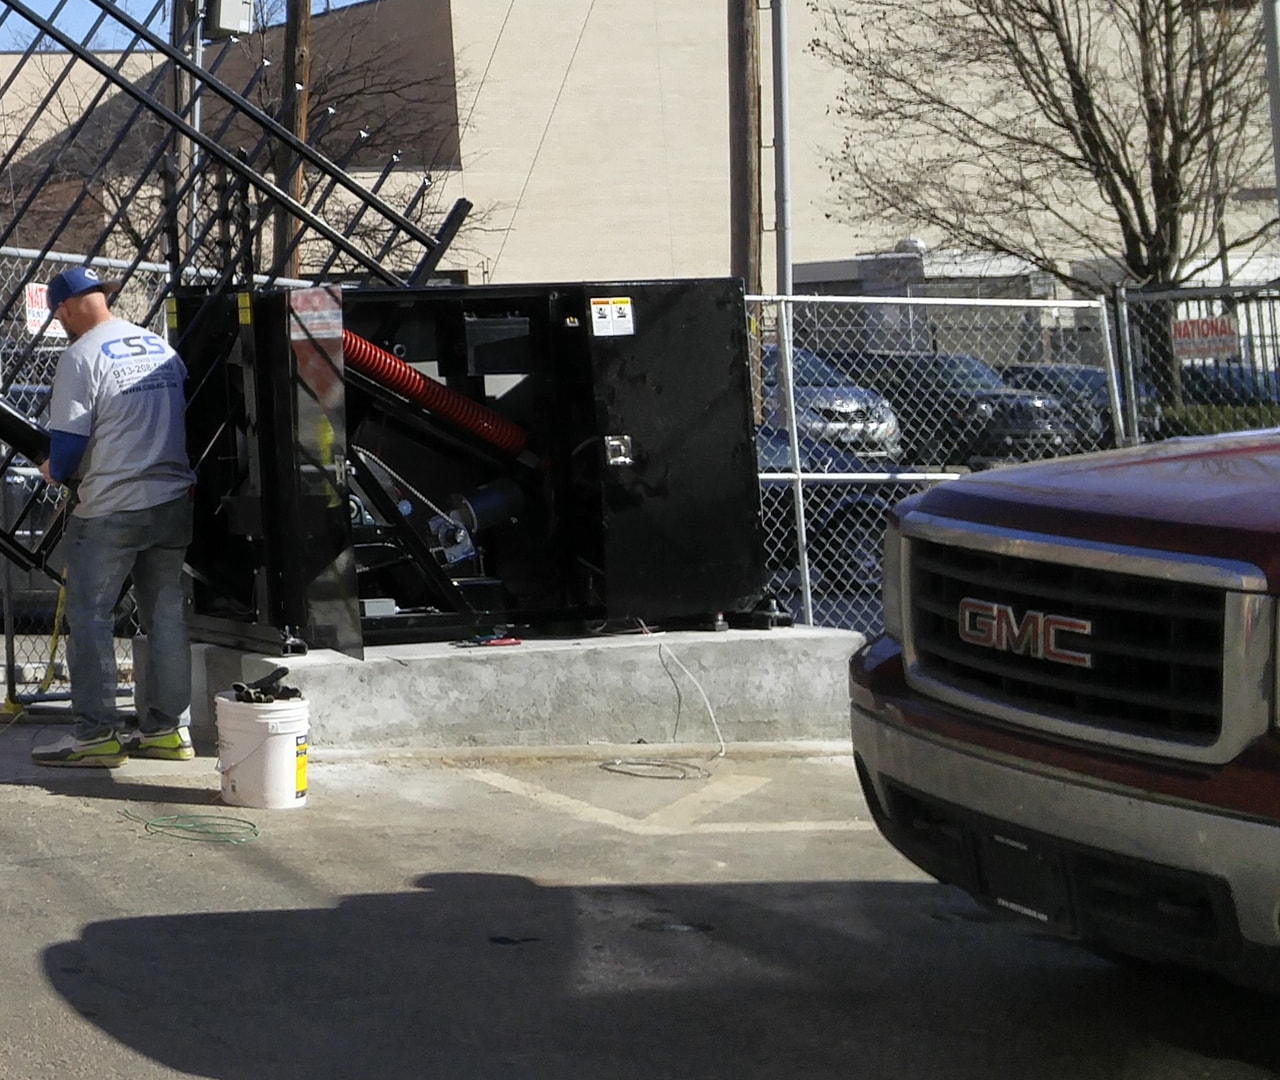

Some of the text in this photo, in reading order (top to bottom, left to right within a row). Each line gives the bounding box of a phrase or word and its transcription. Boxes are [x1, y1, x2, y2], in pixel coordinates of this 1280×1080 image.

[1173, 317, 1236, 339] NATIONAL
[101, 336, 166, 359] CSS
[959, 596, 1092, 668] GMC
